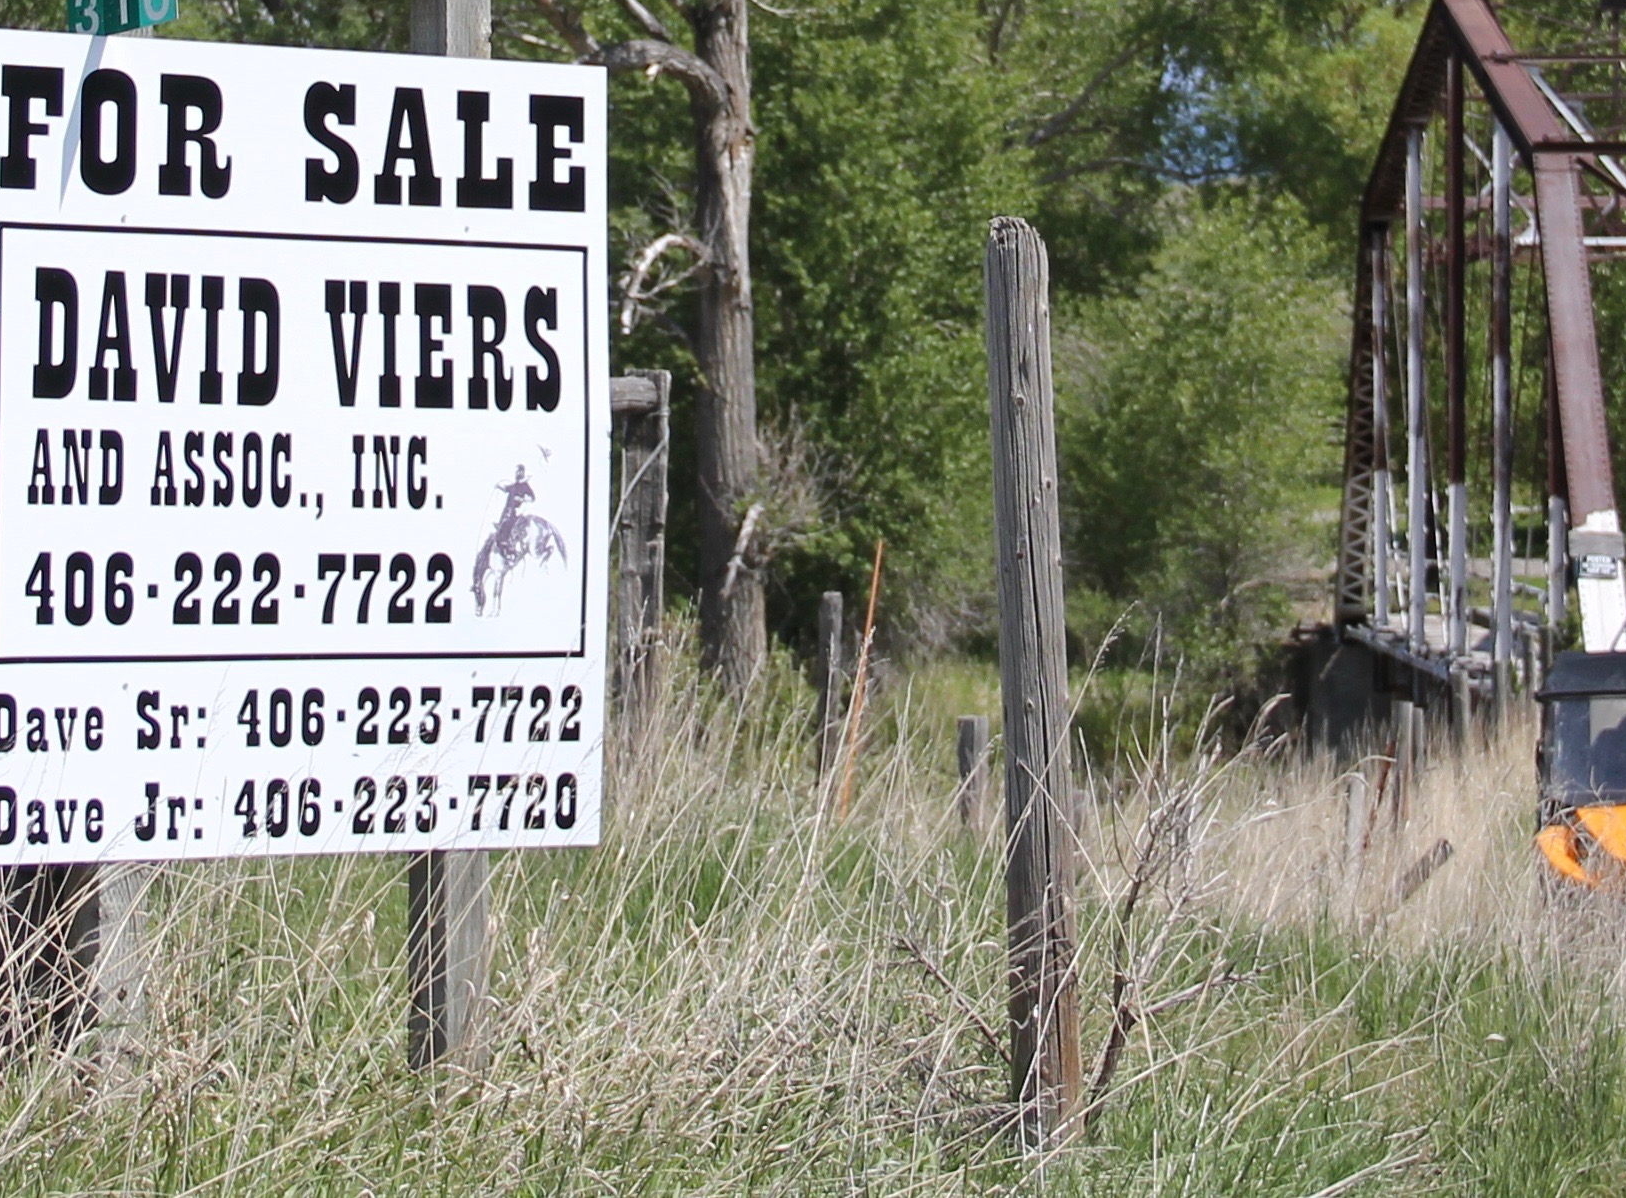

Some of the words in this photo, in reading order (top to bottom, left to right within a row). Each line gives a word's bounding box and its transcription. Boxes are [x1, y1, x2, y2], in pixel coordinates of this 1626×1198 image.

[0, 64, 232, 199] FOR
[303, 81, 585, 213] SALE
[32, 267, 280, 407] DAVID
[324, 279, 562, 413] VIERS
[27, 428, 124, 507] AND
[150, 431, 324, 520] ASSOC.,
[351, 435, 444, 510] INC.
[136, 690, 206, 750] Sr:
[134, 782, 204, 842] Jr:
